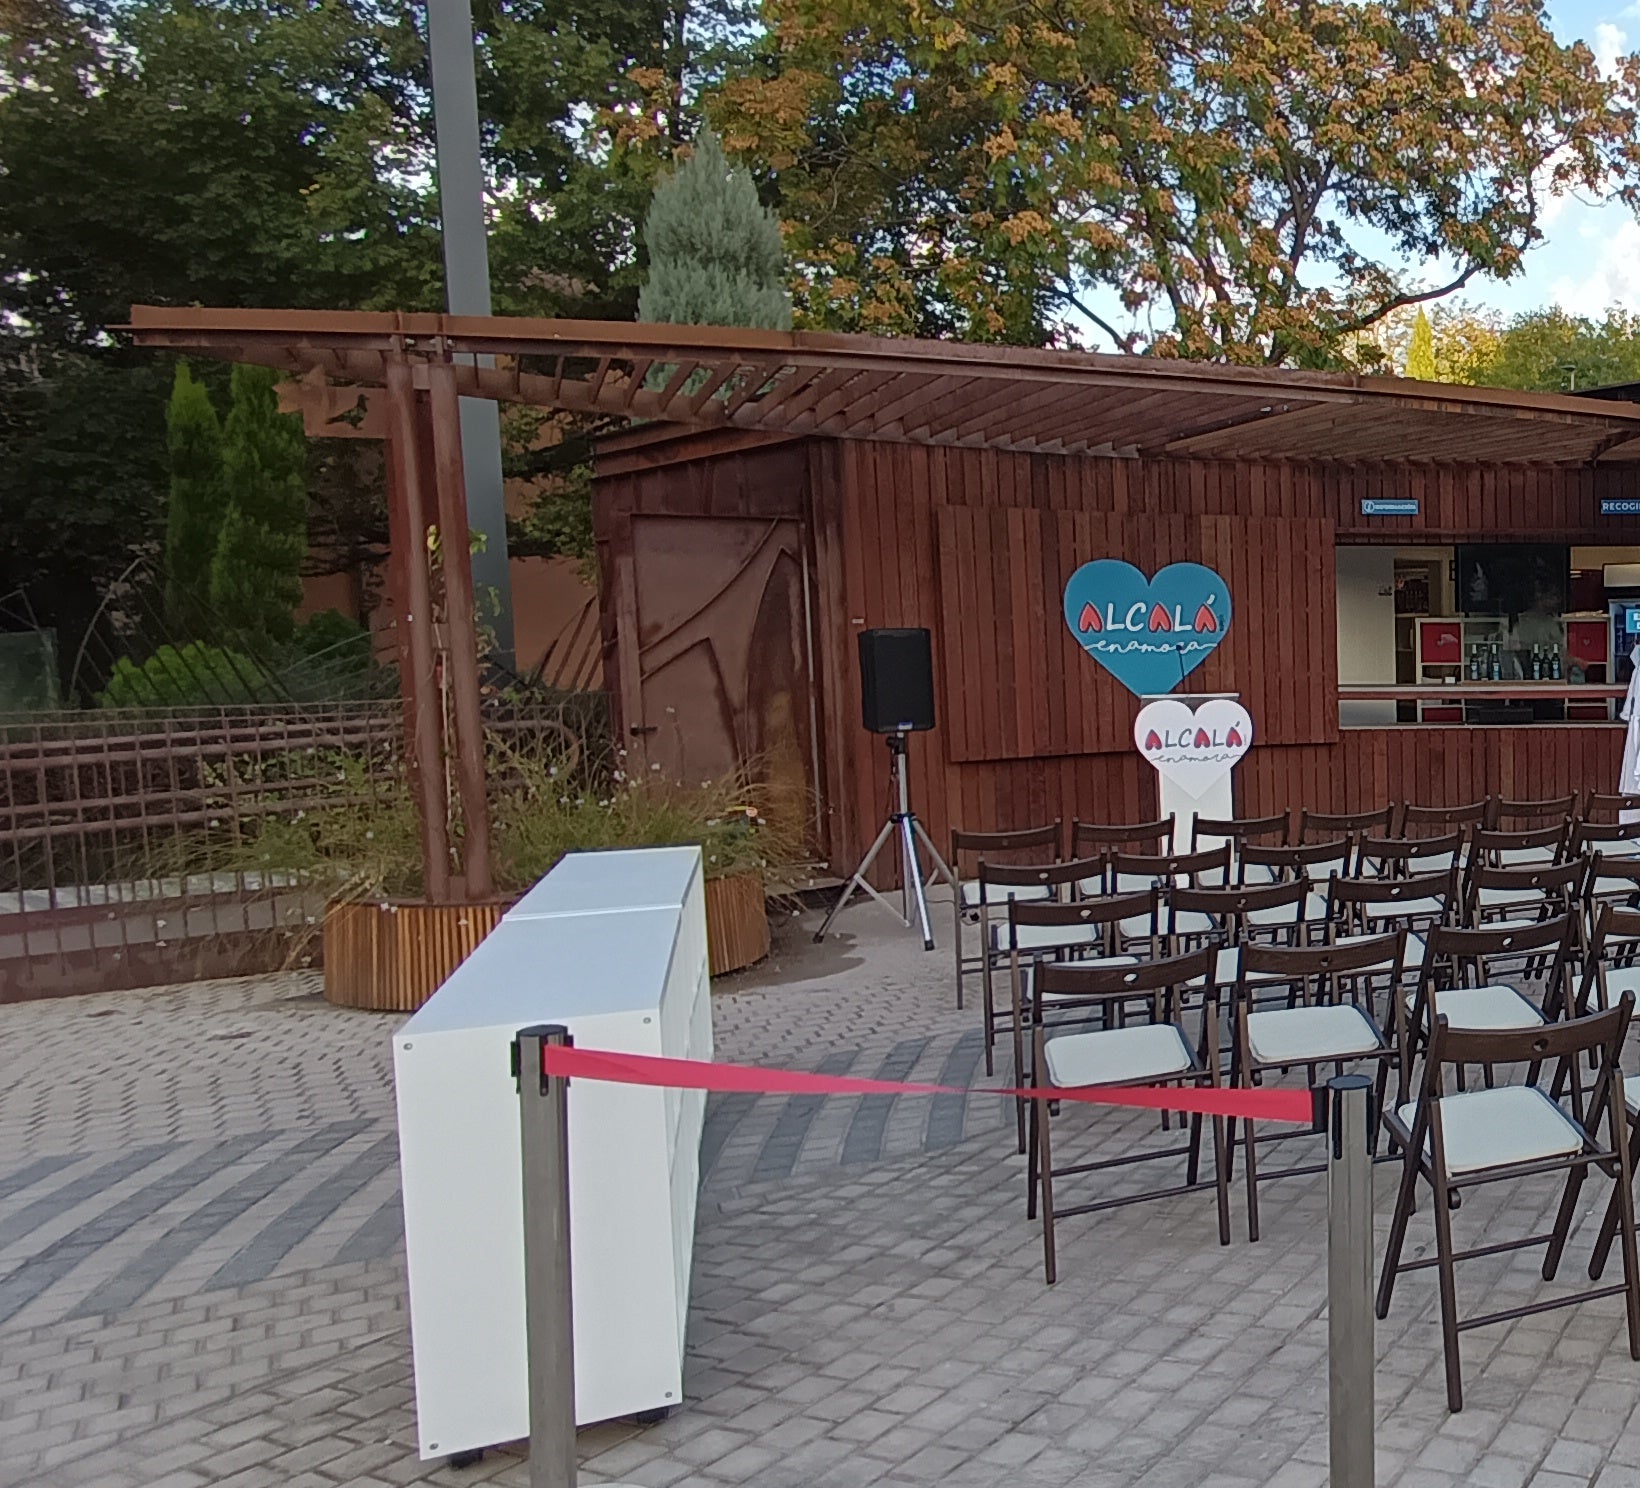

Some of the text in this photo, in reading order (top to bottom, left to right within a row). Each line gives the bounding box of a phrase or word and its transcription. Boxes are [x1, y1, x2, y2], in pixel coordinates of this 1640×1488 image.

[1078, 594, 1218, 633] ALCALÁ
[1086, 638, 1216, 655] enamora
[1144, 721, 1243, 750] ALCALÁ
[1151, 752, 1242, 763] enamora
